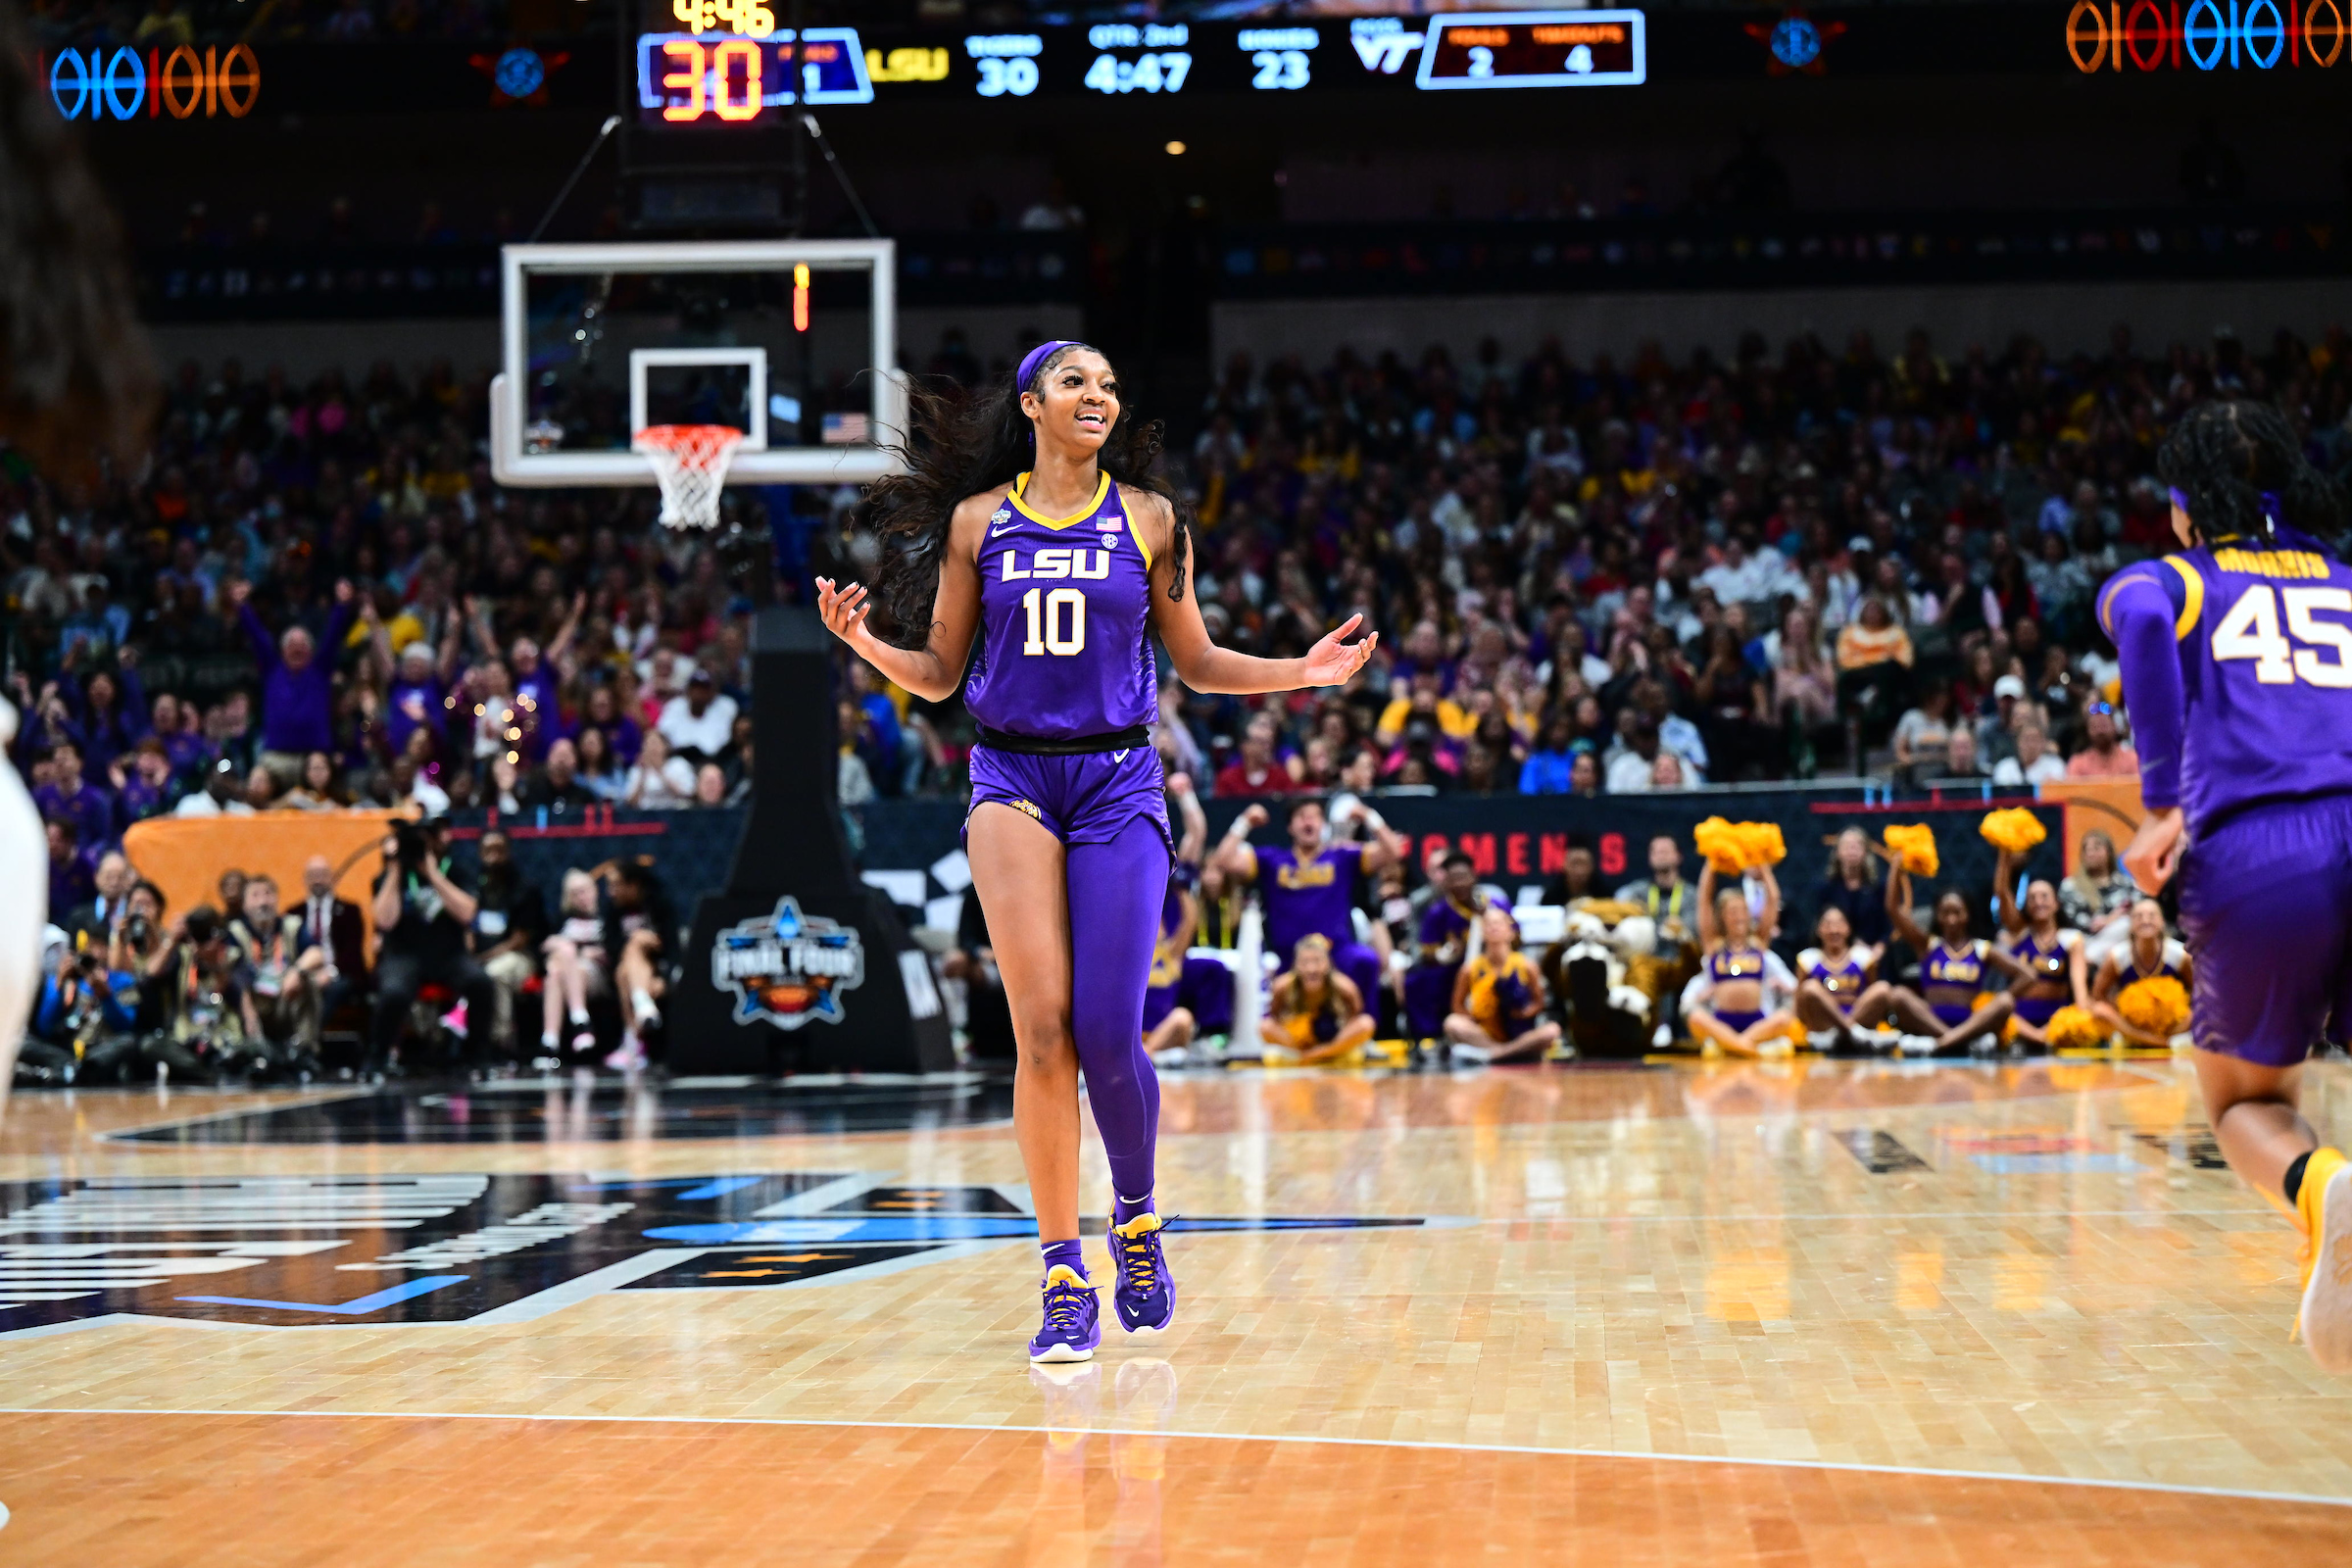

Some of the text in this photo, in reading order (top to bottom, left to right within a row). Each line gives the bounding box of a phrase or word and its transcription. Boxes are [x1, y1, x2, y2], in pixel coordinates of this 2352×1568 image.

[865, 48, 950, 81] LSU
[1251, 51, 1310, 89] 23
[1350, 32, 1425, 74] VT
[1467, 46, 1494, 78] 2
[1565, 44, 1593, 74] 4
[663, 40, 761, 121] 30
[976, 57, 1039, 96] 30
[1085, 52, 1192, 94] 4:47
[1102, 535, 1117, 546] SEC
[1002, 549, 1110, 582] LSU
[1023, 588, 1086, 656] 10
[2211, 583, 2352, 688] 45
